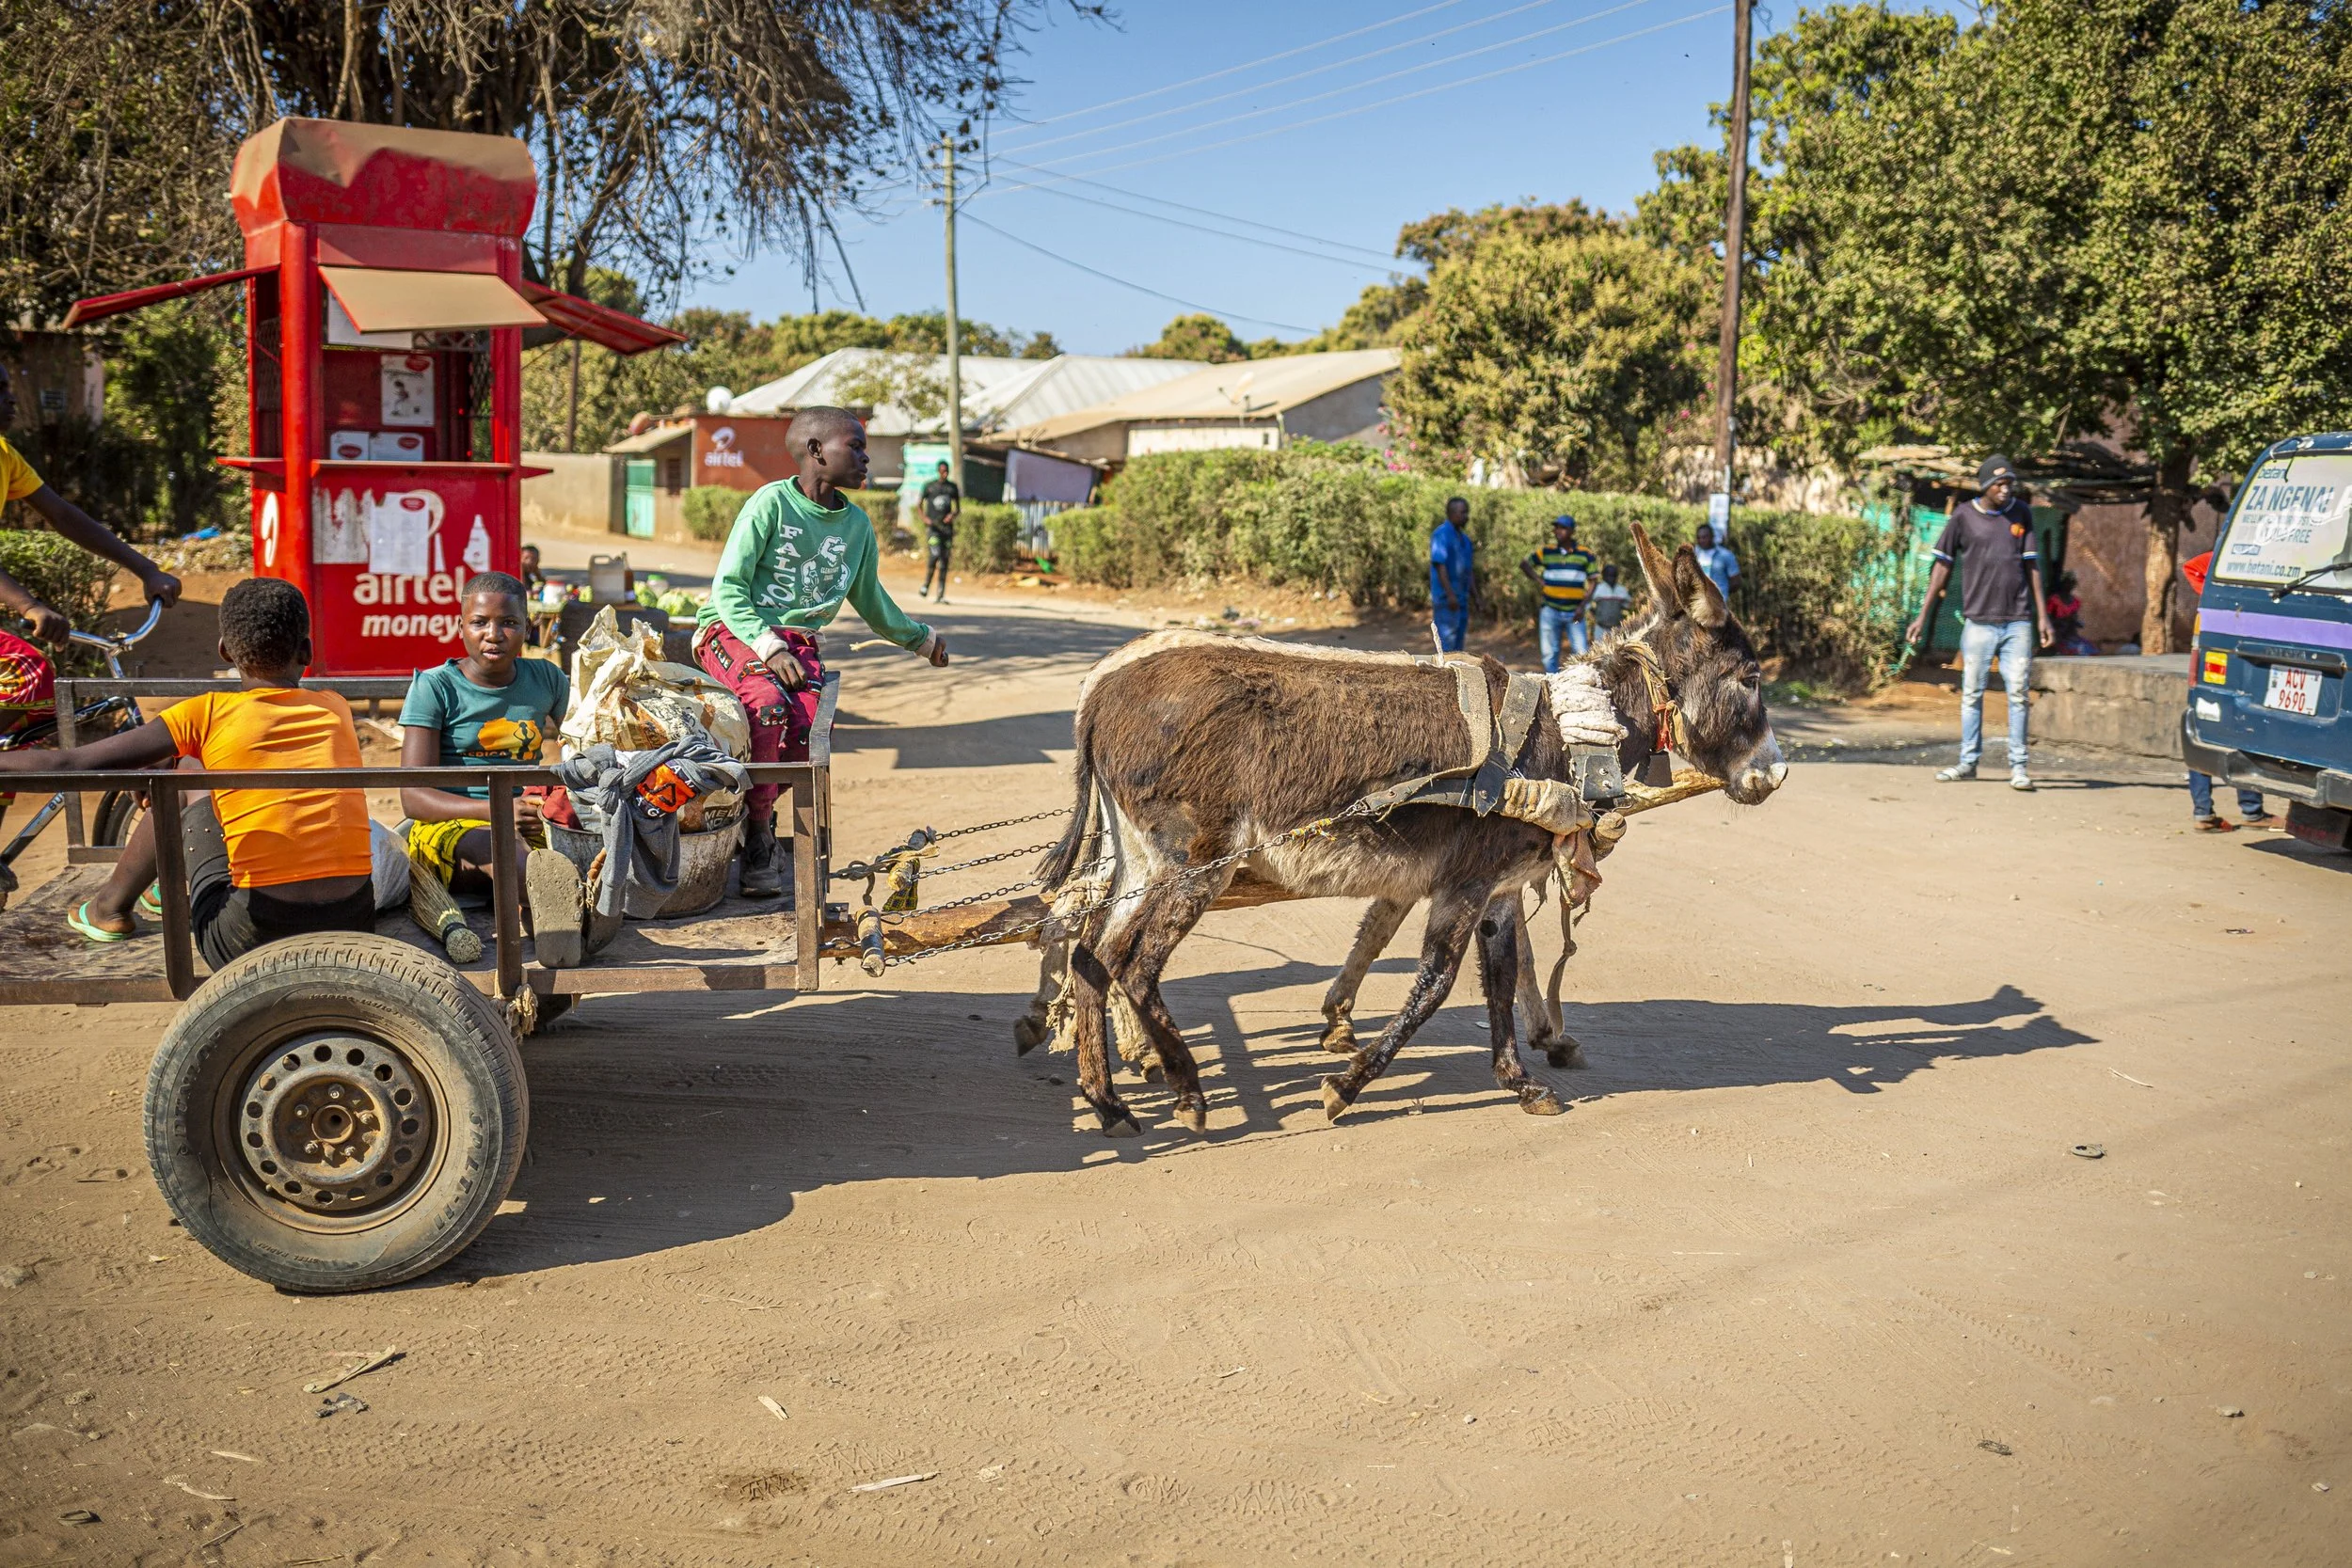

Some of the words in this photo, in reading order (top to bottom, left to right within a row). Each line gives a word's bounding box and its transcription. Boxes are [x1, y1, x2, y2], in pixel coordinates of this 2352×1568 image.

[704, 450, 745, 467] airtel
[2246, 485, 2268, 511] ZA
[353, 566, 467, 606] airtel
[360, 613, 460, 644] money
[2285, 668, 2307, 690] ACV
[2279, 689, 2307, 712] 9690
[172, 1024, 227, 1138] DUNLOP
